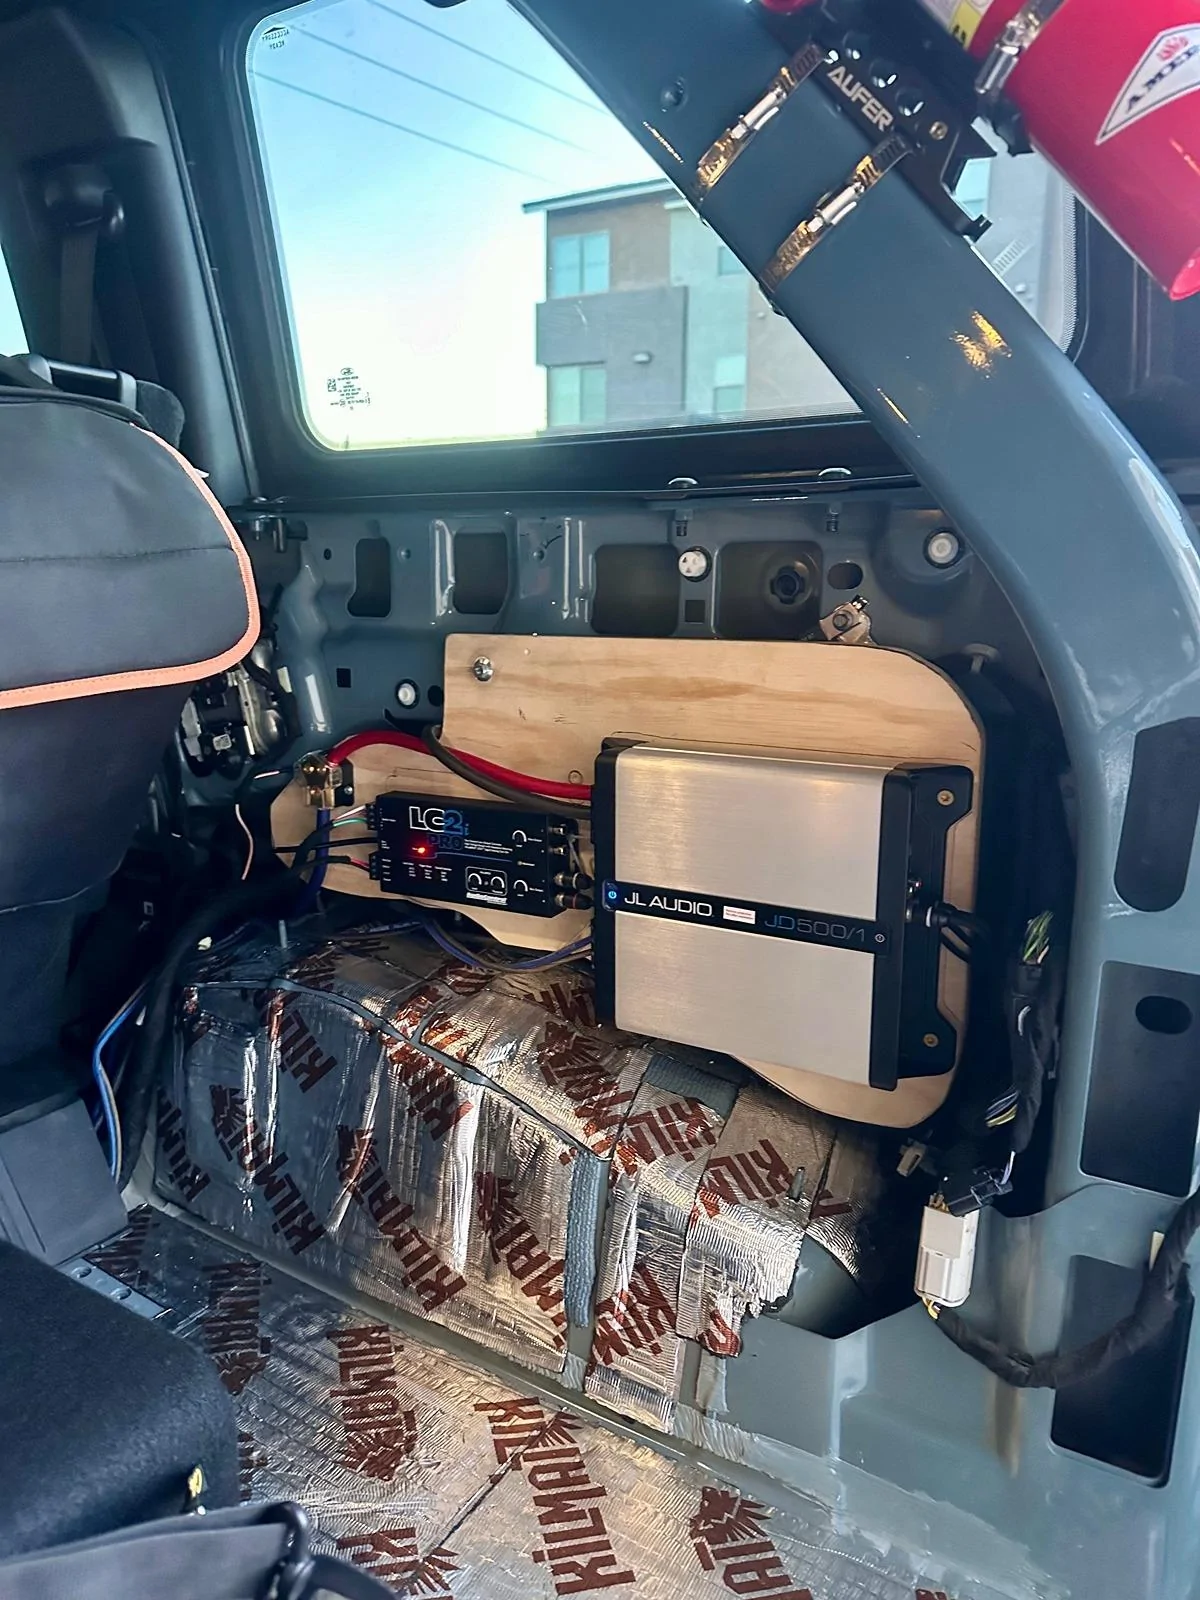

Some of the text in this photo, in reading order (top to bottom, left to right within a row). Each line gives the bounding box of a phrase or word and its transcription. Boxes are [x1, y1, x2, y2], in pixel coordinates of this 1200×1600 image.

[827, 66, 893, 131] AUFER
[427, 833, 463, 851] PRO
[624, 892, 647, 907] JL
[649, 895, 713, 917] AUDIO
[764, 915, 865, 942] JD500/1
[219, 1120, 327, 1255] KILMAT
[351, 1167, 467, 1312] KILMAT
